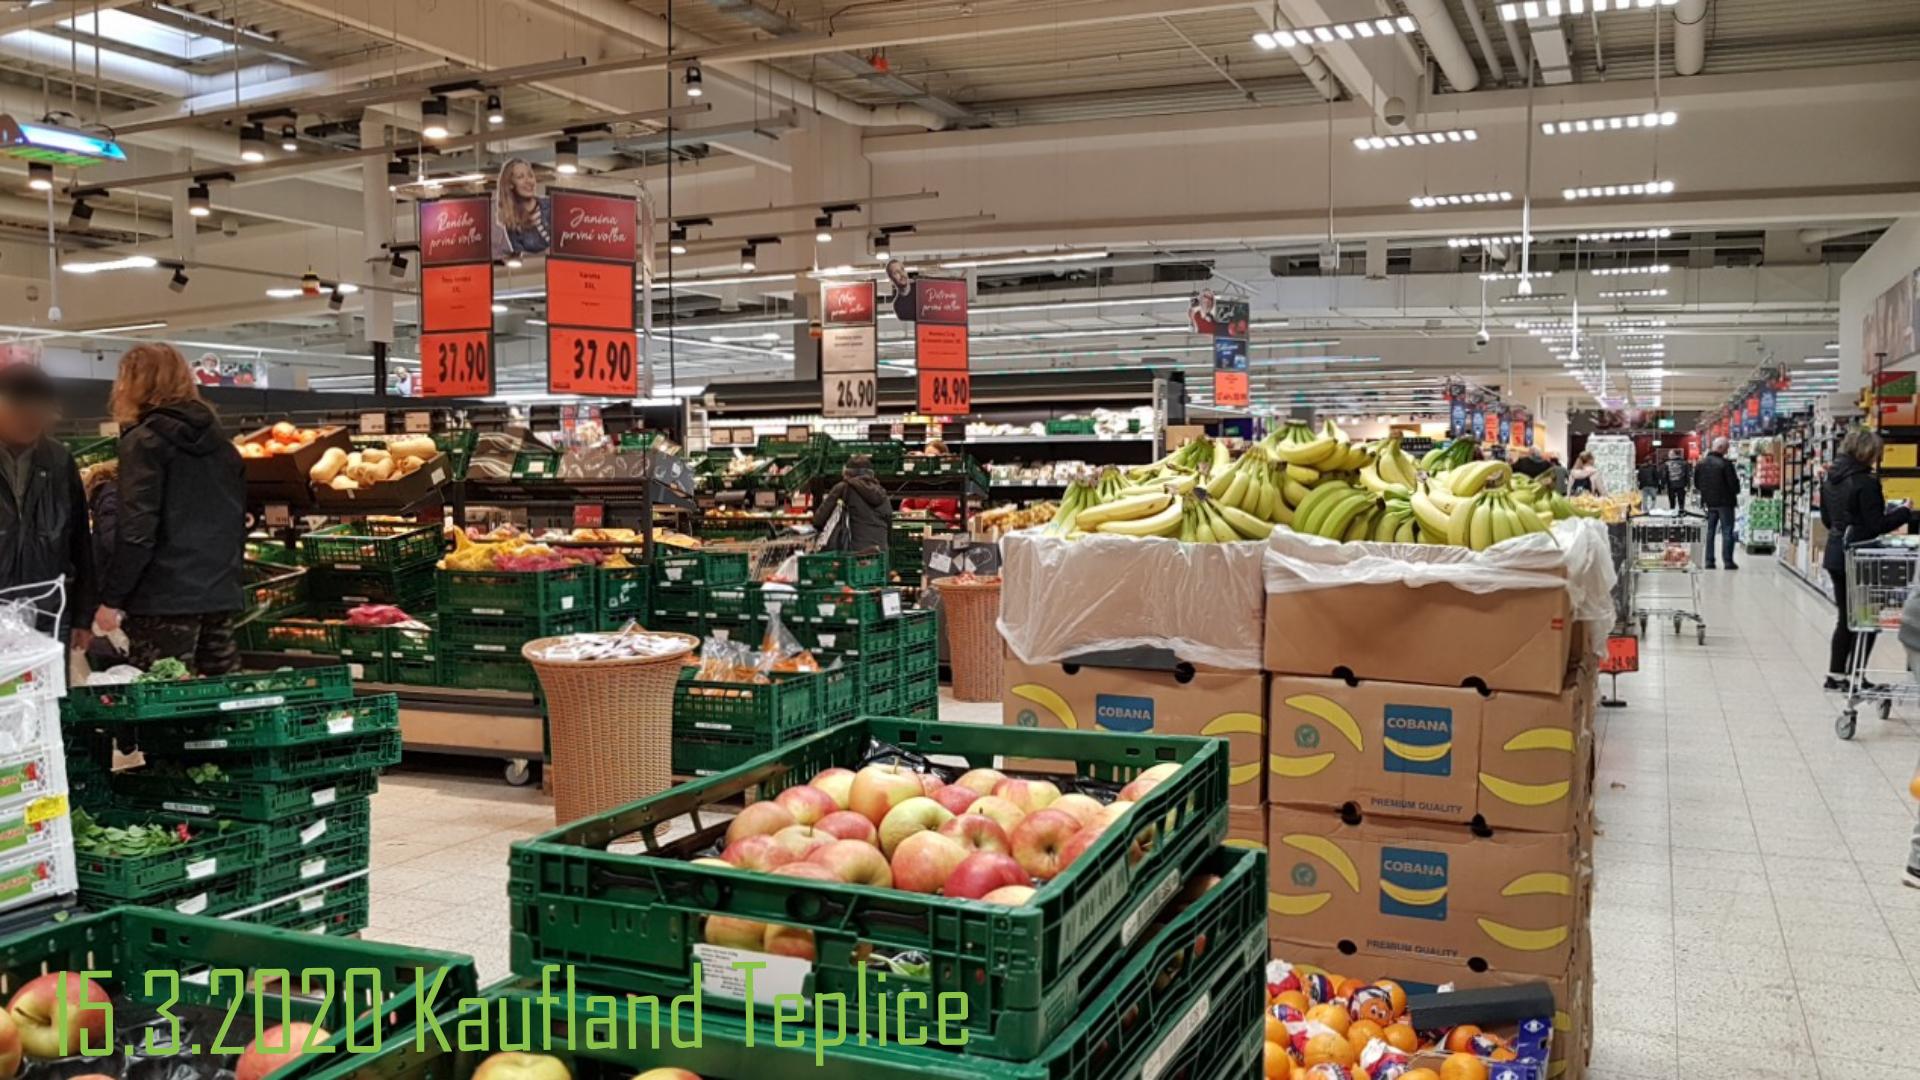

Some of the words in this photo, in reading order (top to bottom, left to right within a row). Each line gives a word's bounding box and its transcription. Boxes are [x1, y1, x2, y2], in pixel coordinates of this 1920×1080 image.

[428, 233, 457, 256] první
[560, 228, 595, 249] první
[597, 226, 626, 244] volba
[438, 341, 486, 384] 37.90
[573, 338, 631, 382] 37.90
[837, 378, 875, 408] 26.90
[933, 376, 967, 406] 84.90
[1098, 706, 1152, 721] COBANA
[1386, 716, 1449, 733] COBANA
[1370, 797, 1416, 810] PREMIUM
[1417, 802, 1463, 815] QUALITY
[1383, 859, 1445, 877] COBANA
[1366, 939, 1413, 953] PREMIUM
[1414, 945, 1459, 958] QUALITY
